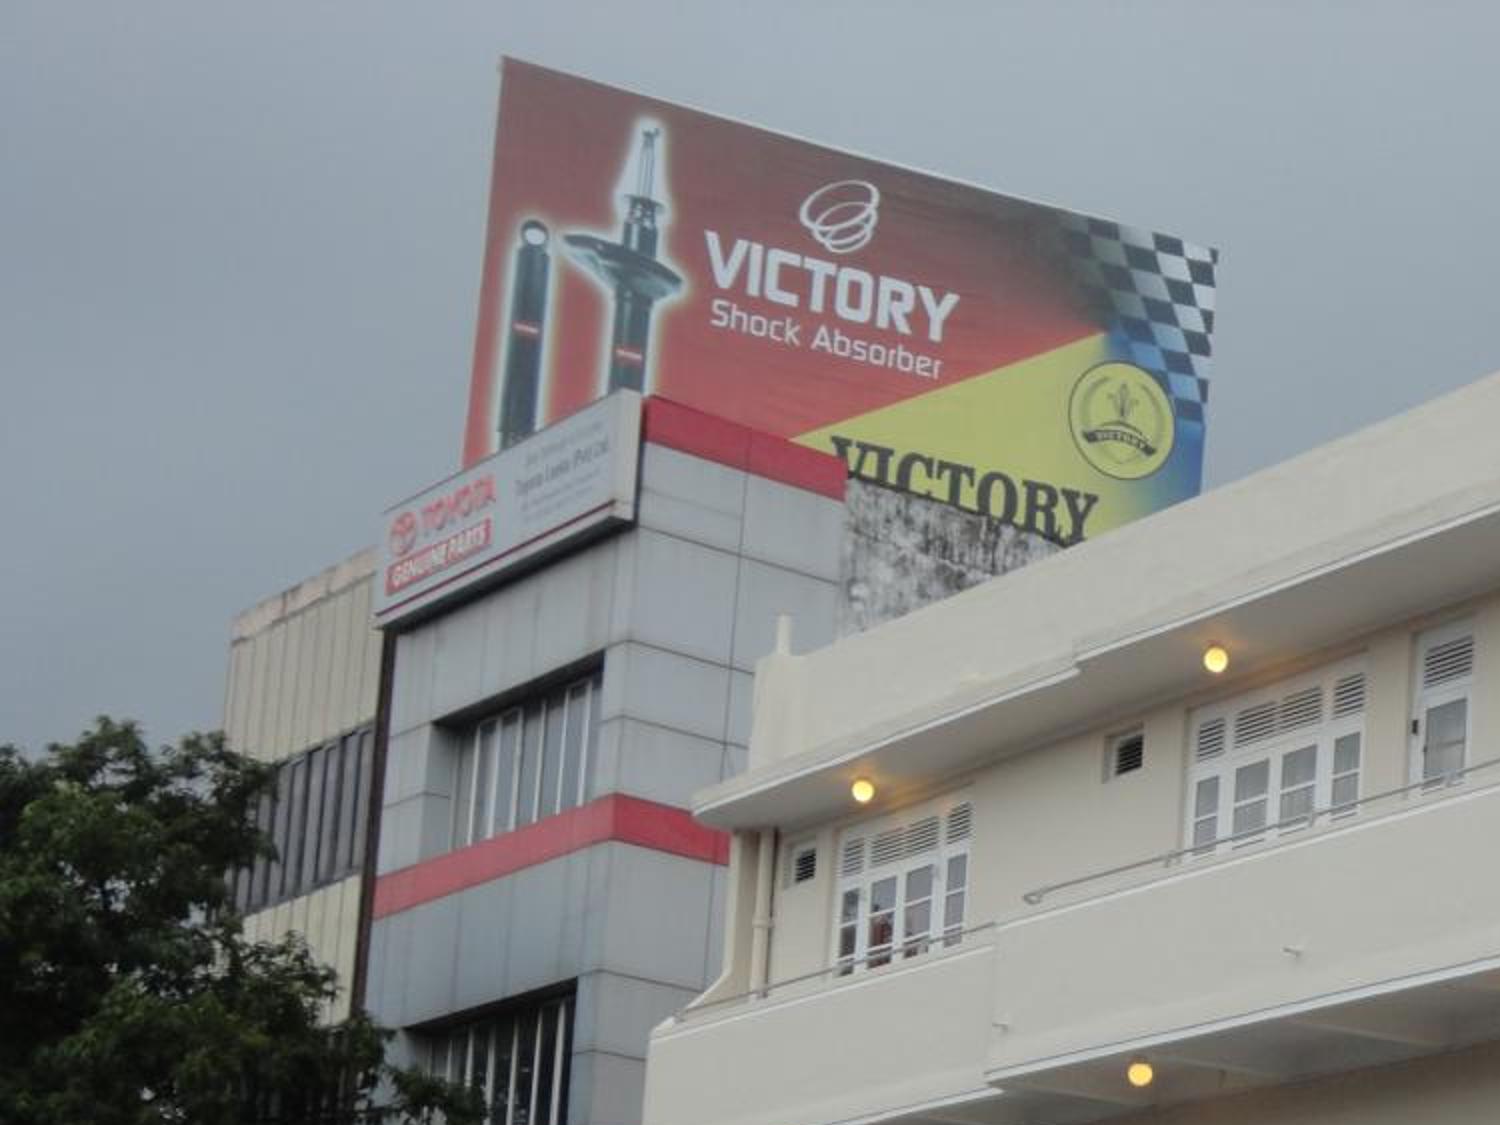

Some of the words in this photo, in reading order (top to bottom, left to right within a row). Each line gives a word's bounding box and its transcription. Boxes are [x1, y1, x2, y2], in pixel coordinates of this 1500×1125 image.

[704, 230, 960, 342] VICTORY
[710, 300, 800, 347] Shock
[811, 328, 943, 381] Absorber
[830, 436, 1098, 546] VICTORY
